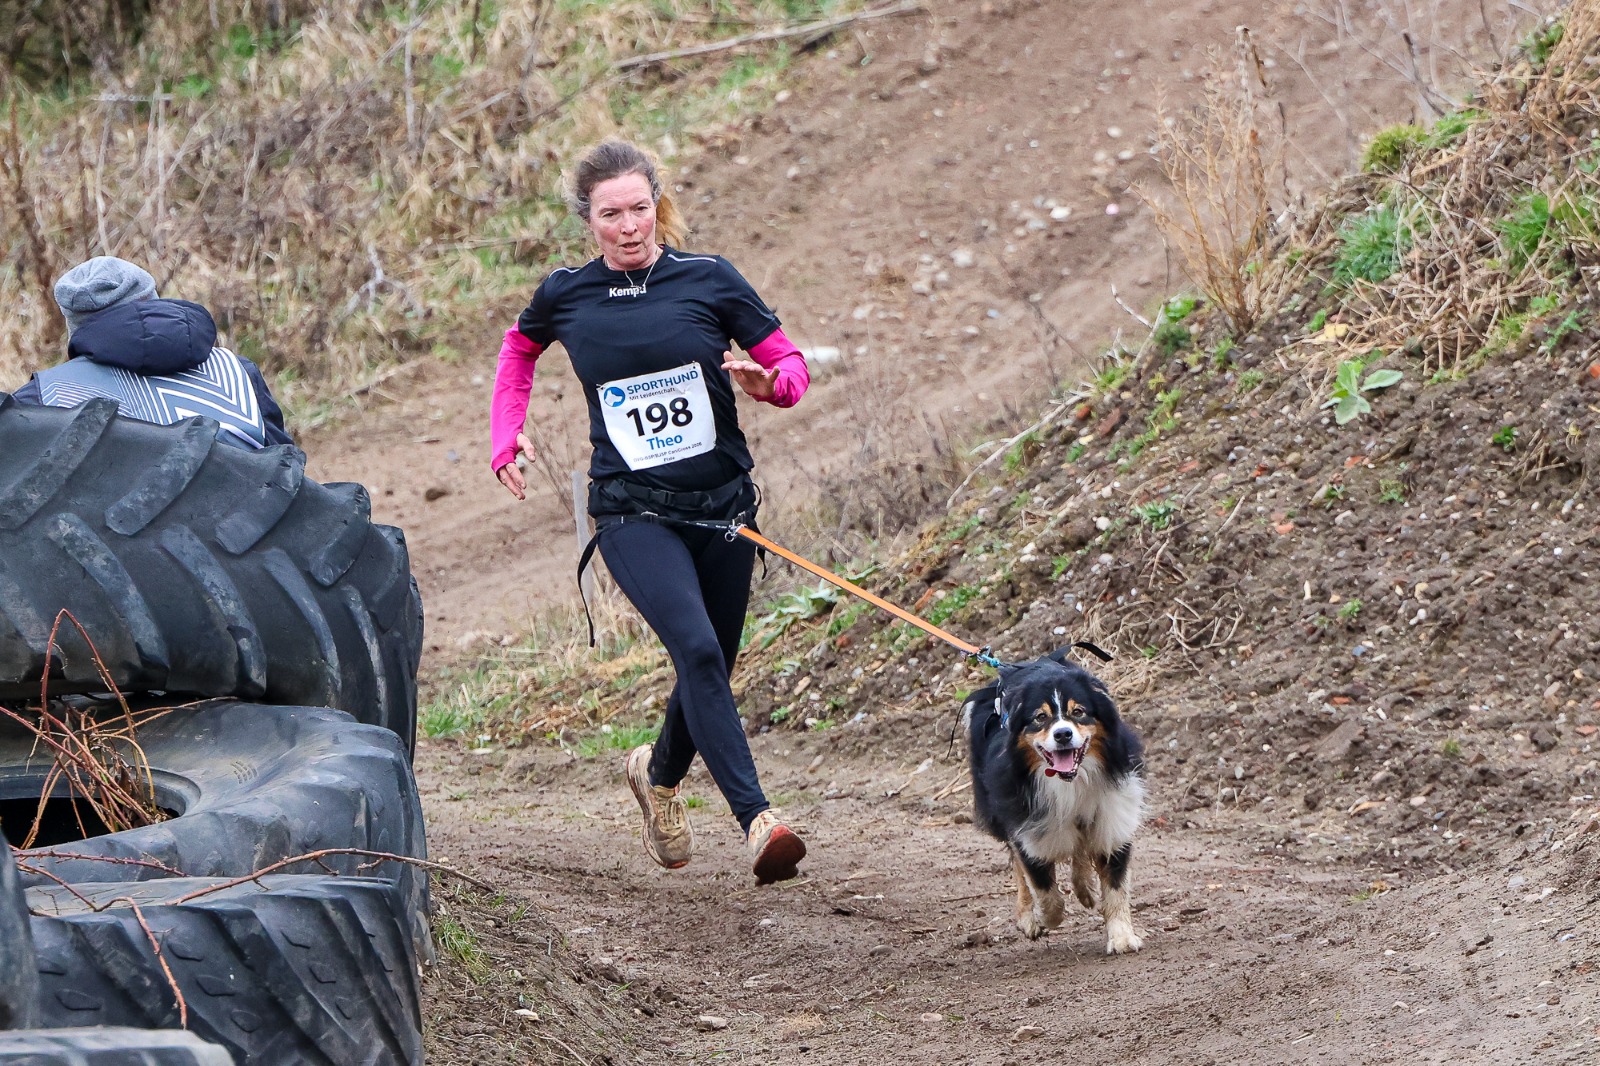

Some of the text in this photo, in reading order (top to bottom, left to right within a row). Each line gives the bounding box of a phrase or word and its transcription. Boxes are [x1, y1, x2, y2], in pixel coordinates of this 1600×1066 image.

[627, 370, 698, 394] SPORTHUND
[640, 387, 676, 399] Leidenschaft
[626, 397, 693, 437] 198
[646, 434, 683, 450] Theo
